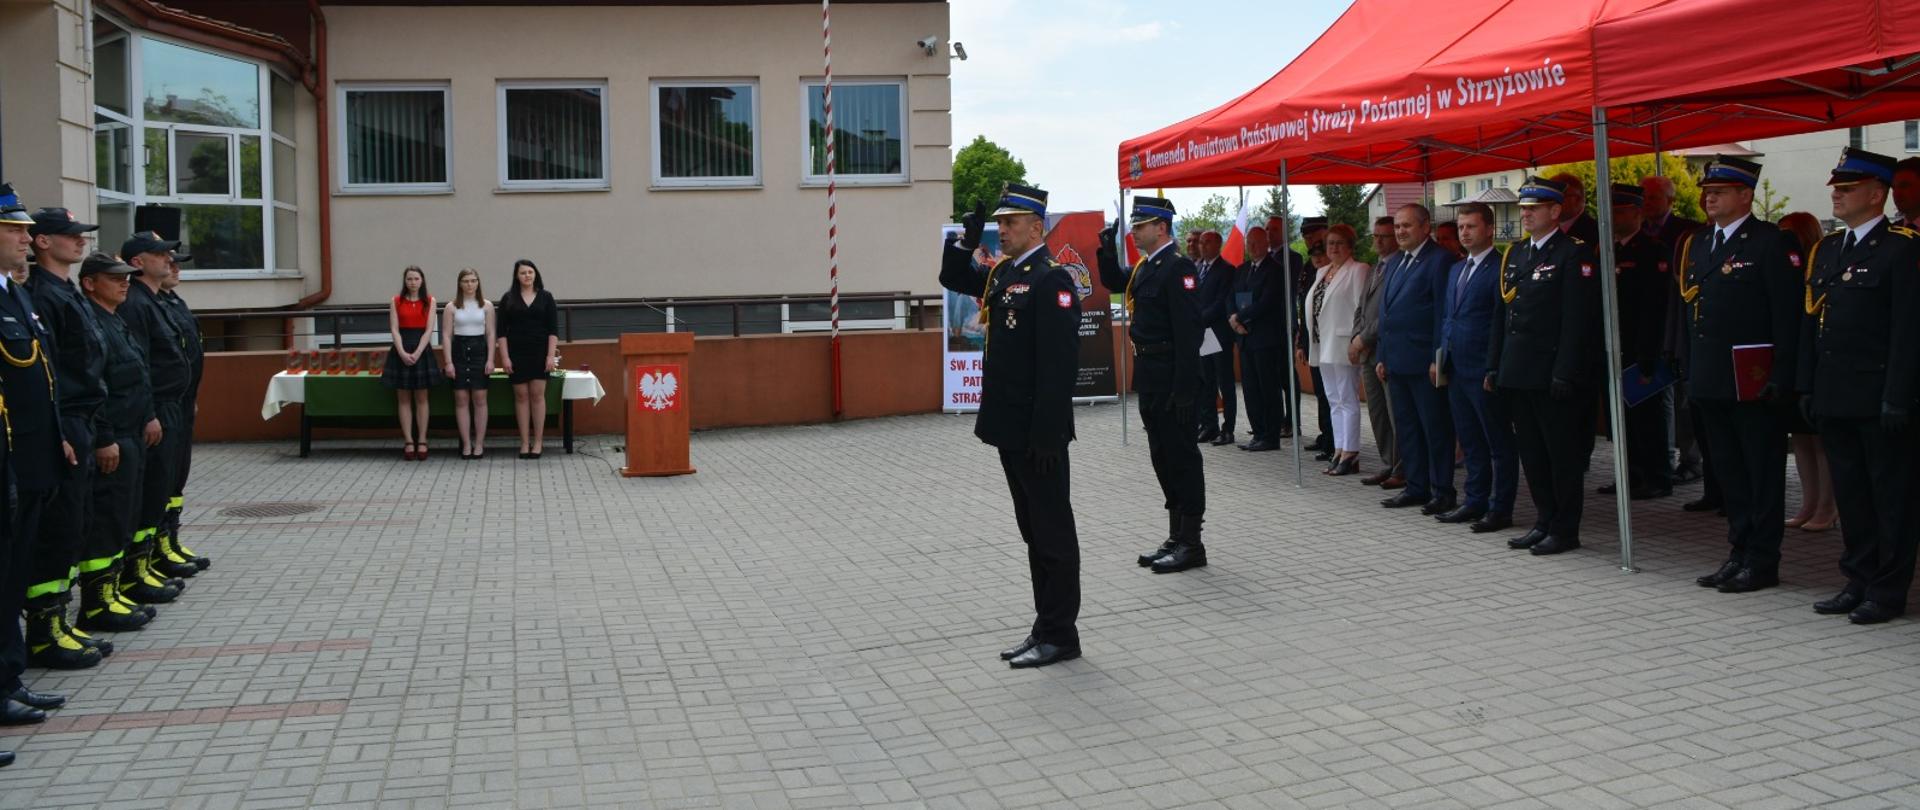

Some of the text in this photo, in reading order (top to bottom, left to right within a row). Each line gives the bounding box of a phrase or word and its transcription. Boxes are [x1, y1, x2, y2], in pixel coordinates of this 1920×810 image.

[1146, 58, 1566, 168] Komenda Powiatowa Państwowej Straży Pożarnej w Strzyżowie
[950, 358, 983, 371] ŚW. FL
[963, 376, 984, 387] PAT
[952, 390, 983, 404] STRAŻ
